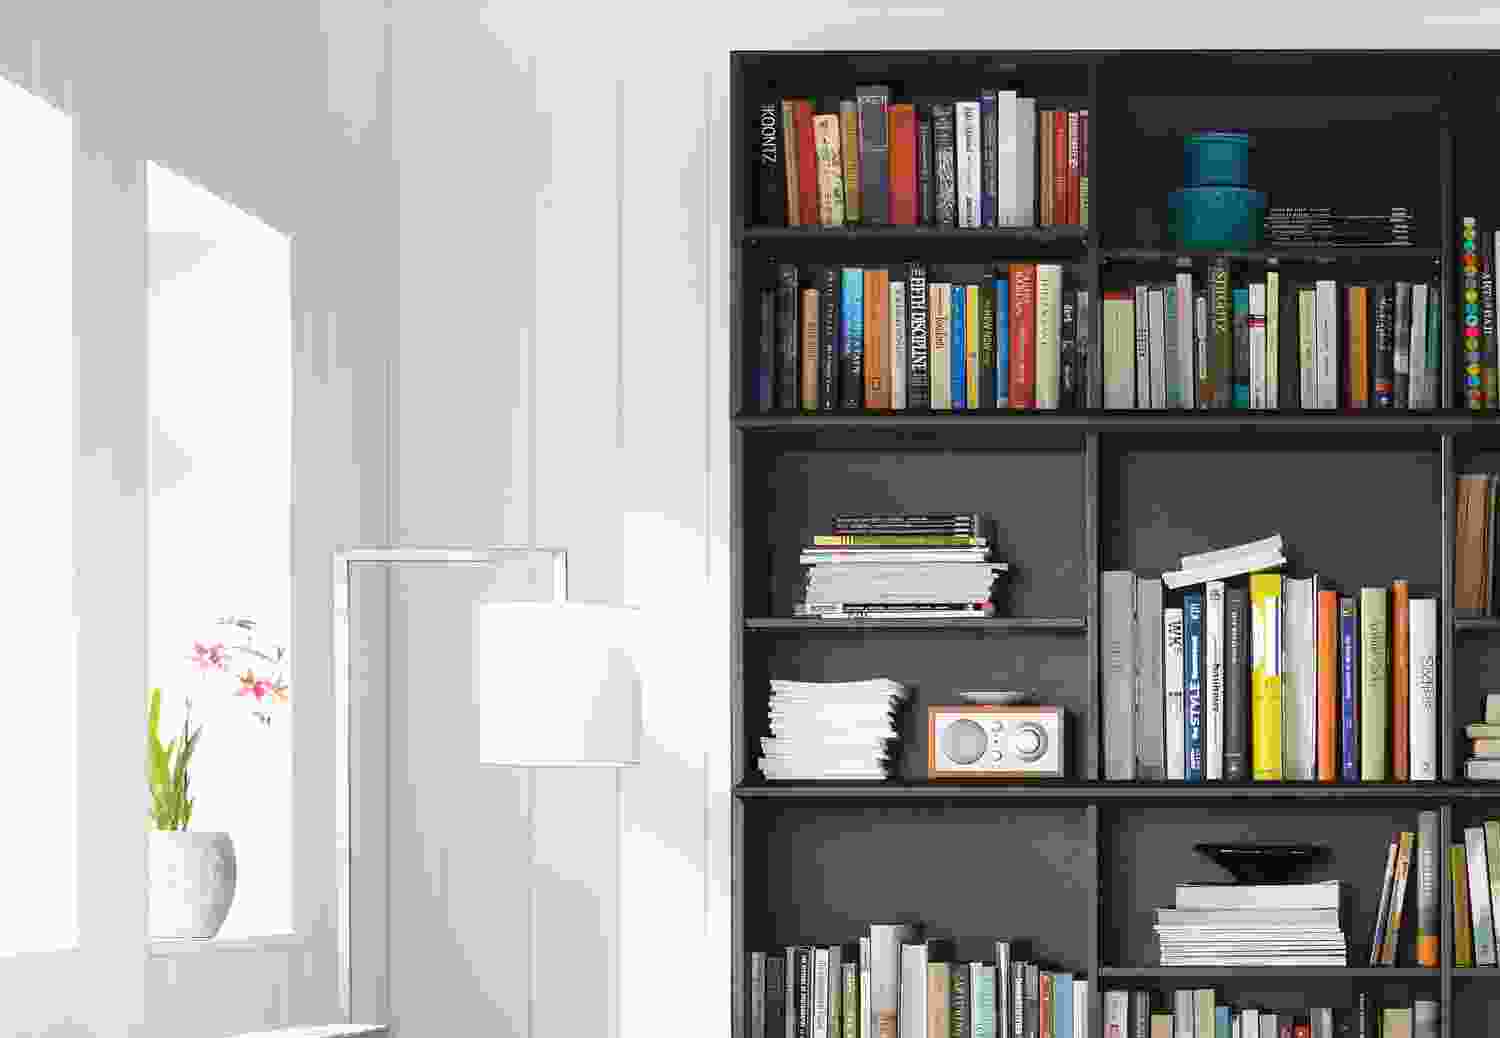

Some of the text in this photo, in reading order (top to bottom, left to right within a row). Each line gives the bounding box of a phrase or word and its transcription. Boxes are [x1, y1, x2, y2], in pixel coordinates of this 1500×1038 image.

[761, 108, 777, 164] KOONTZ
[911, 277, 927, 370] FIFTH DISCIPLINE
